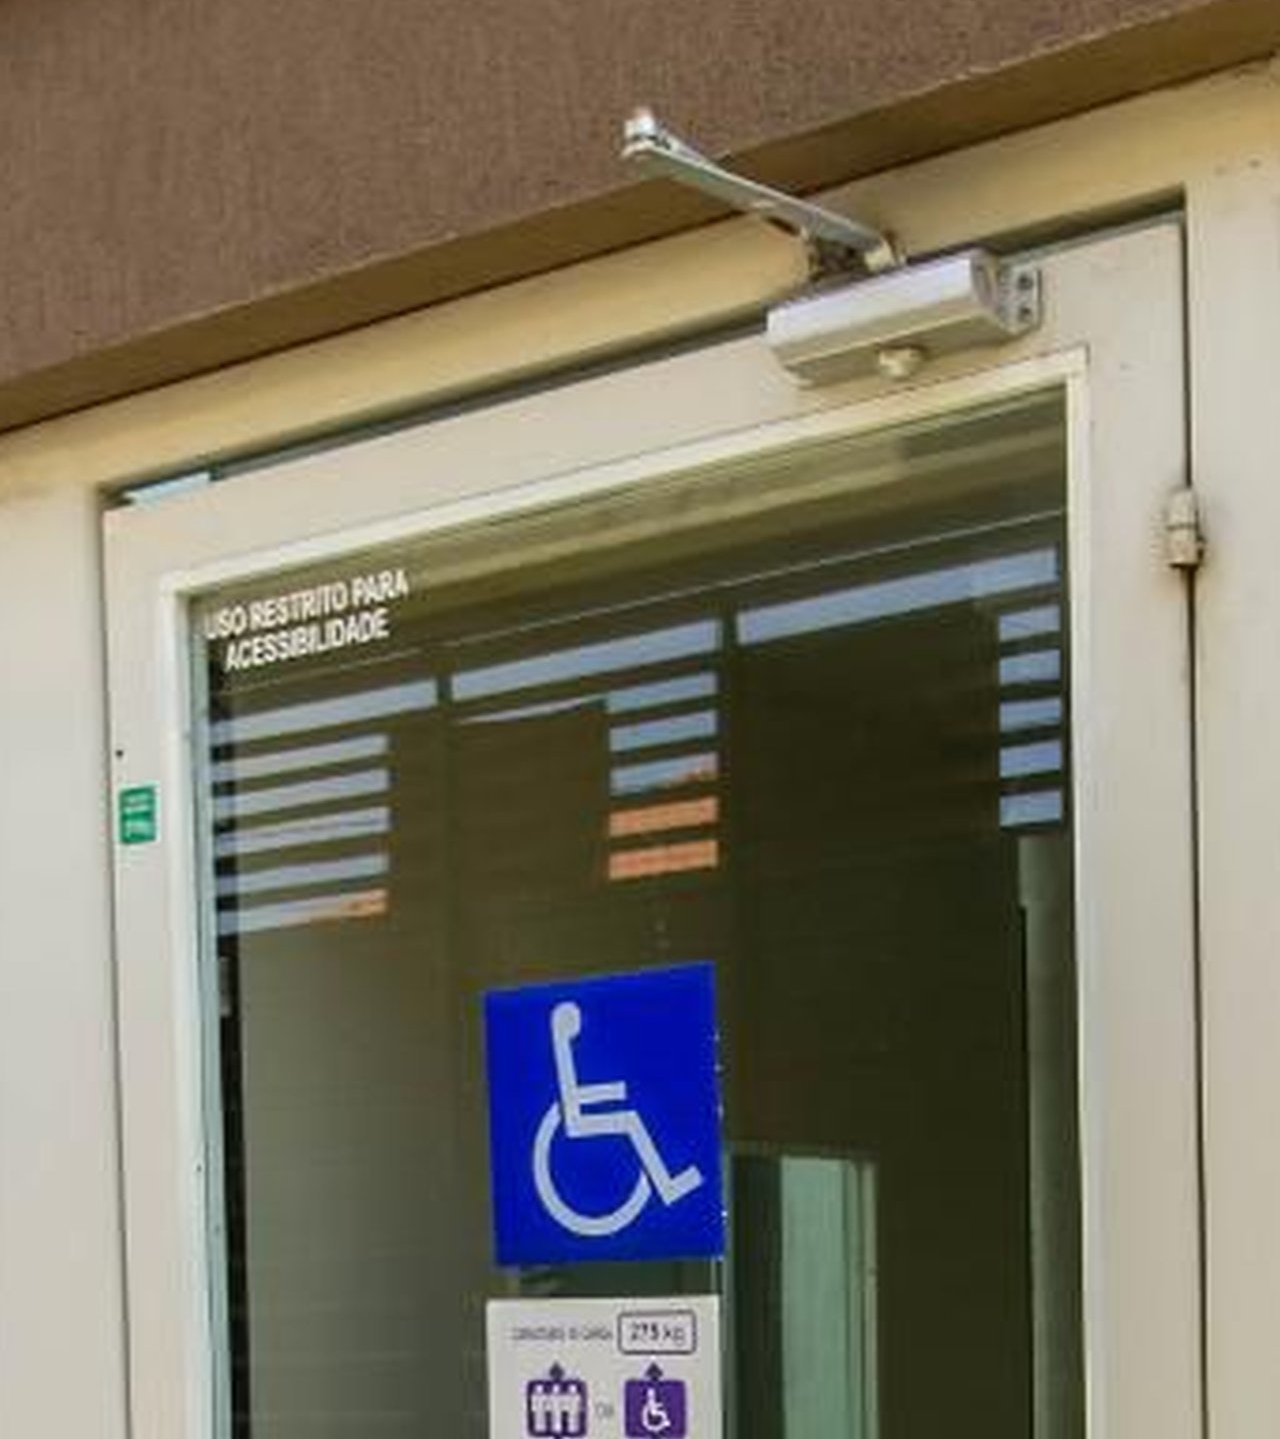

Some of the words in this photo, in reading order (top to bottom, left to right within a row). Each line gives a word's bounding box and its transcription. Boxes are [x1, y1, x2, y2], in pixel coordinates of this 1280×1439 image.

[203, 605, 248, 640] USO
[250, 581, 349, 632] RESTRITO
[351, 568, 409, 607] PARA
[223, 606, 391, 673] ACESSIBILIDADE
